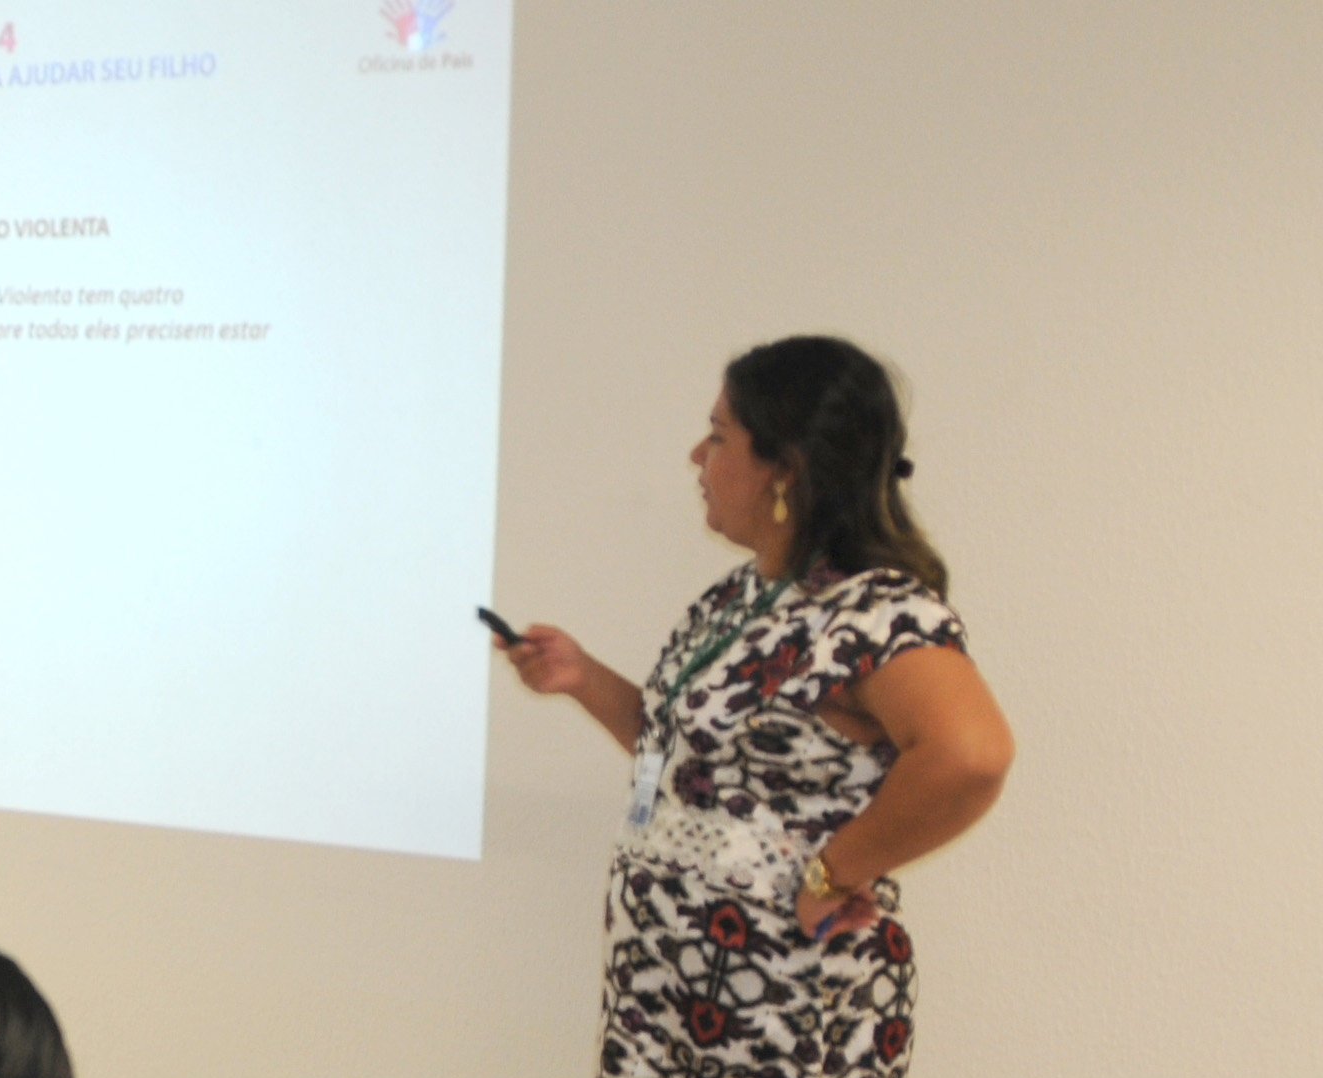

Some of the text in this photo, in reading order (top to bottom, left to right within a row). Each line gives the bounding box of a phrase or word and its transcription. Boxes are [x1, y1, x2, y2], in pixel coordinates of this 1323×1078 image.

[7, 59, 95, 86] AJUDAR
[102, 56, 141, 80] SEU
[150, 52, 216, 77] FILHO
[359, 51, 474, 74] Oficina de Pais
[16, 216, 110, 238] VIOLENTA
[79, 287, 114, 304] tem
[119, 286, 184, 310] quatro
[28, 318, 79, 339] todos
[86, 318, 120, 339] eles
[124, 319, 214, 345] precisem
[219, 320, 273, 340] estar
